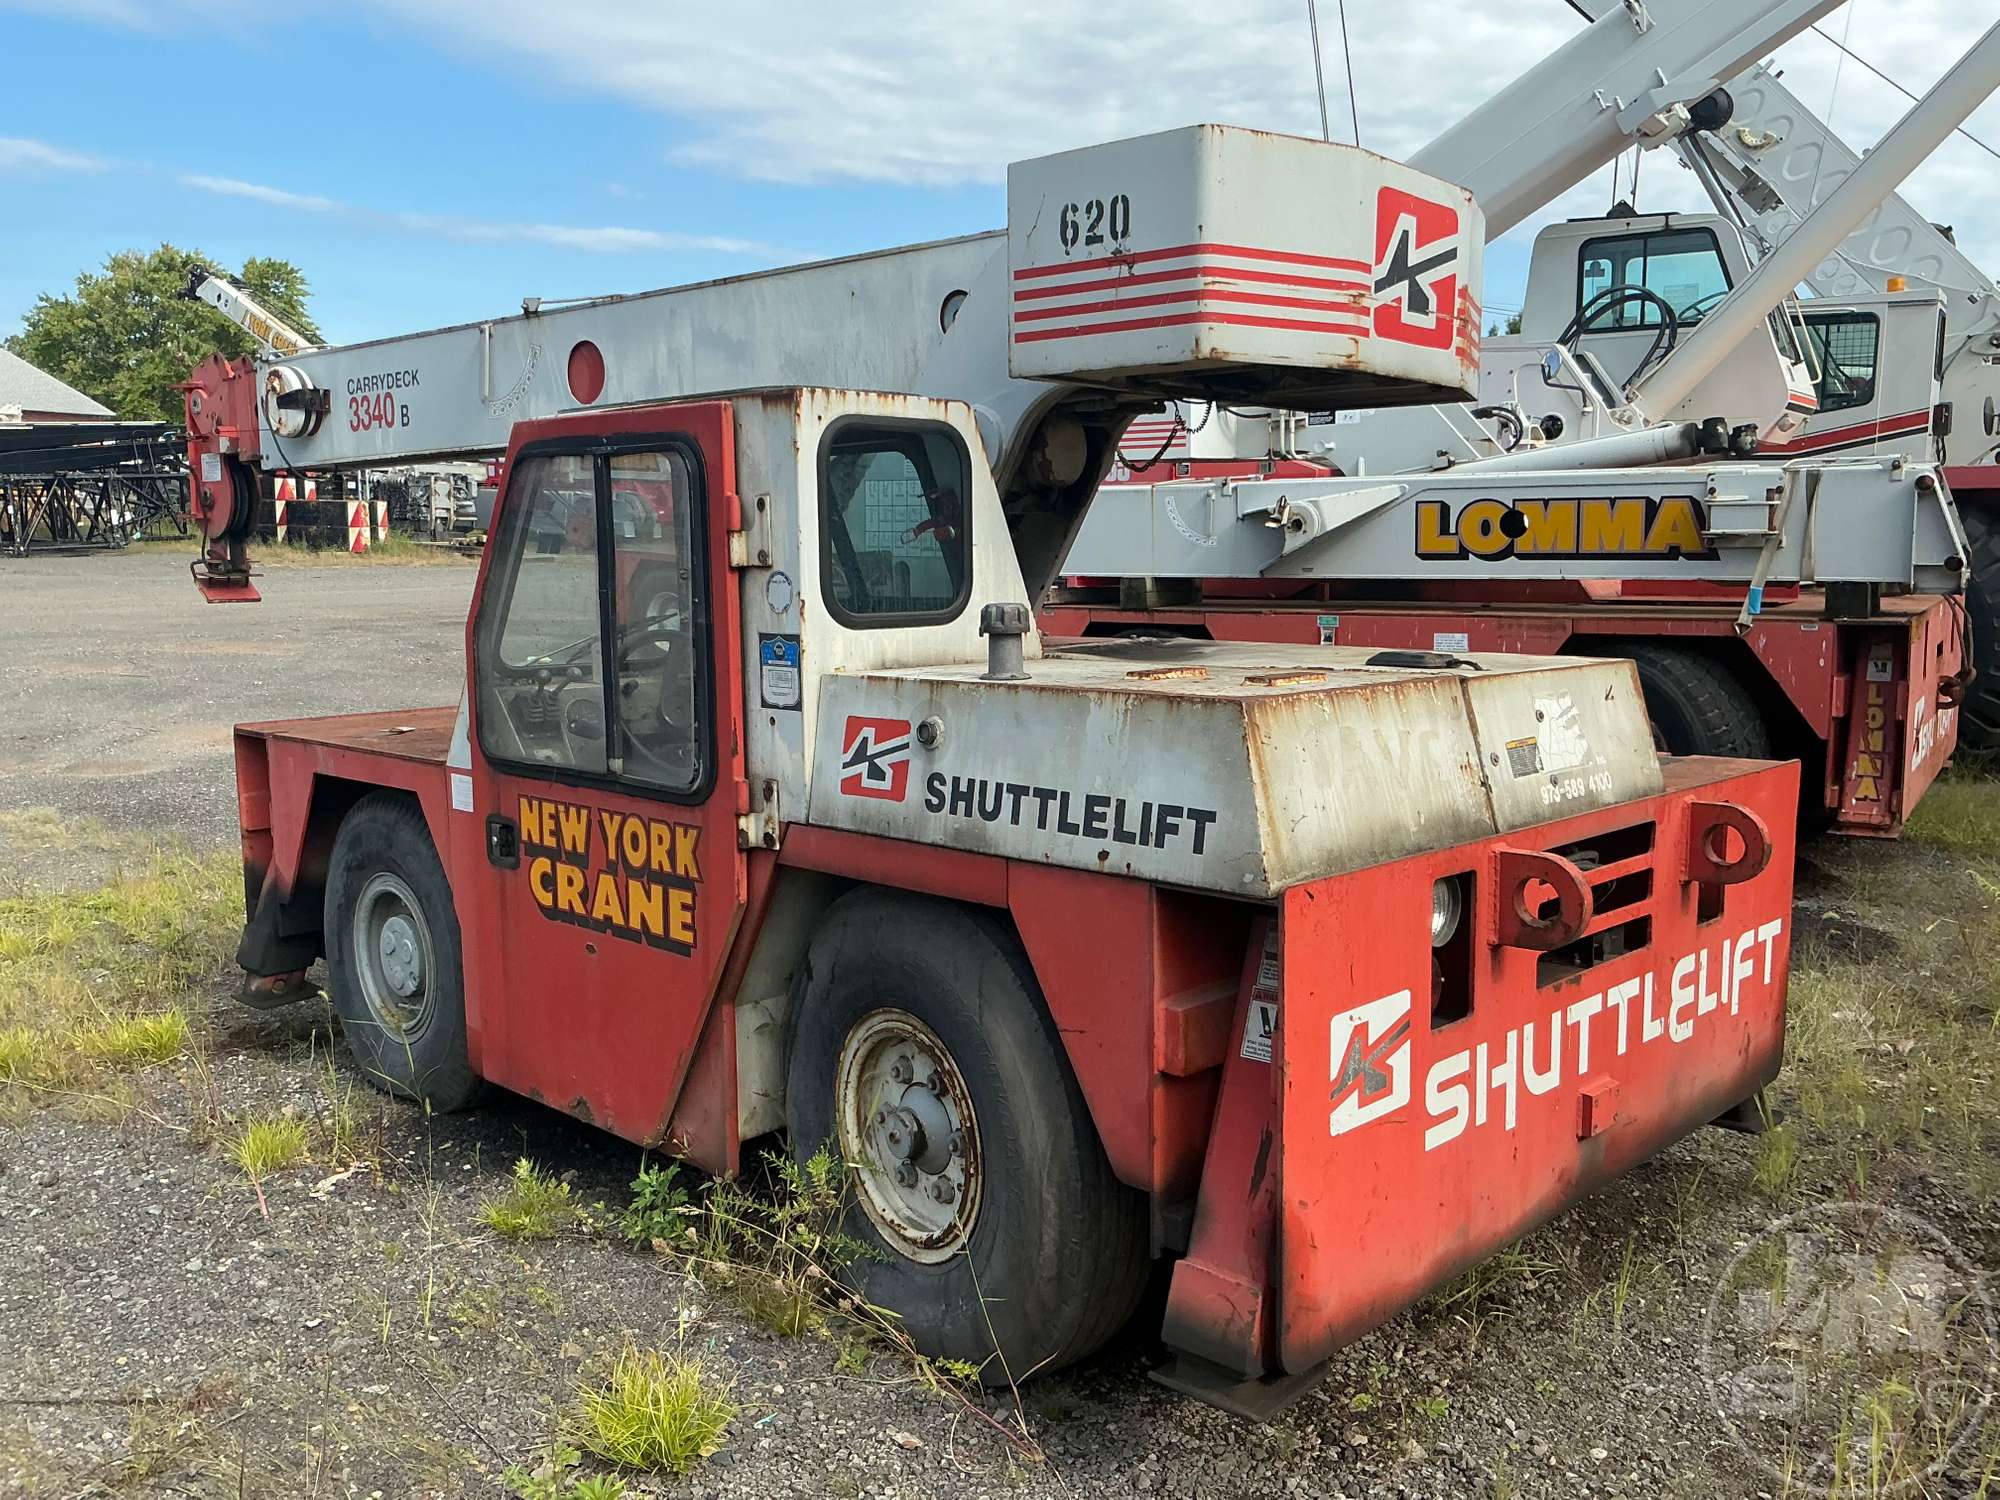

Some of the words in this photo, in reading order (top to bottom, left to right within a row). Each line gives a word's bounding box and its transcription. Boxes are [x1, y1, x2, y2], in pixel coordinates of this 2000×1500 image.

[1059, 193, 1130, 249] 620
[347, 368, 420, 396] CARRYDECK
[349, 391, 396, 433] 3340
[400, 404, 411, 428] B
[1415, 495, 1716, 561] LOMMA
[924, 772, 1217, 856] SHUTTLELIFT
[1588, 771, 1612, 794] 4100
[518, 794, 592, 864] NEW
[598, 808, 703, 883] YORK
[529, 857, 697, 952] CRANE
[1424, 917, 1782, 1152] SHUTTLELIFT
